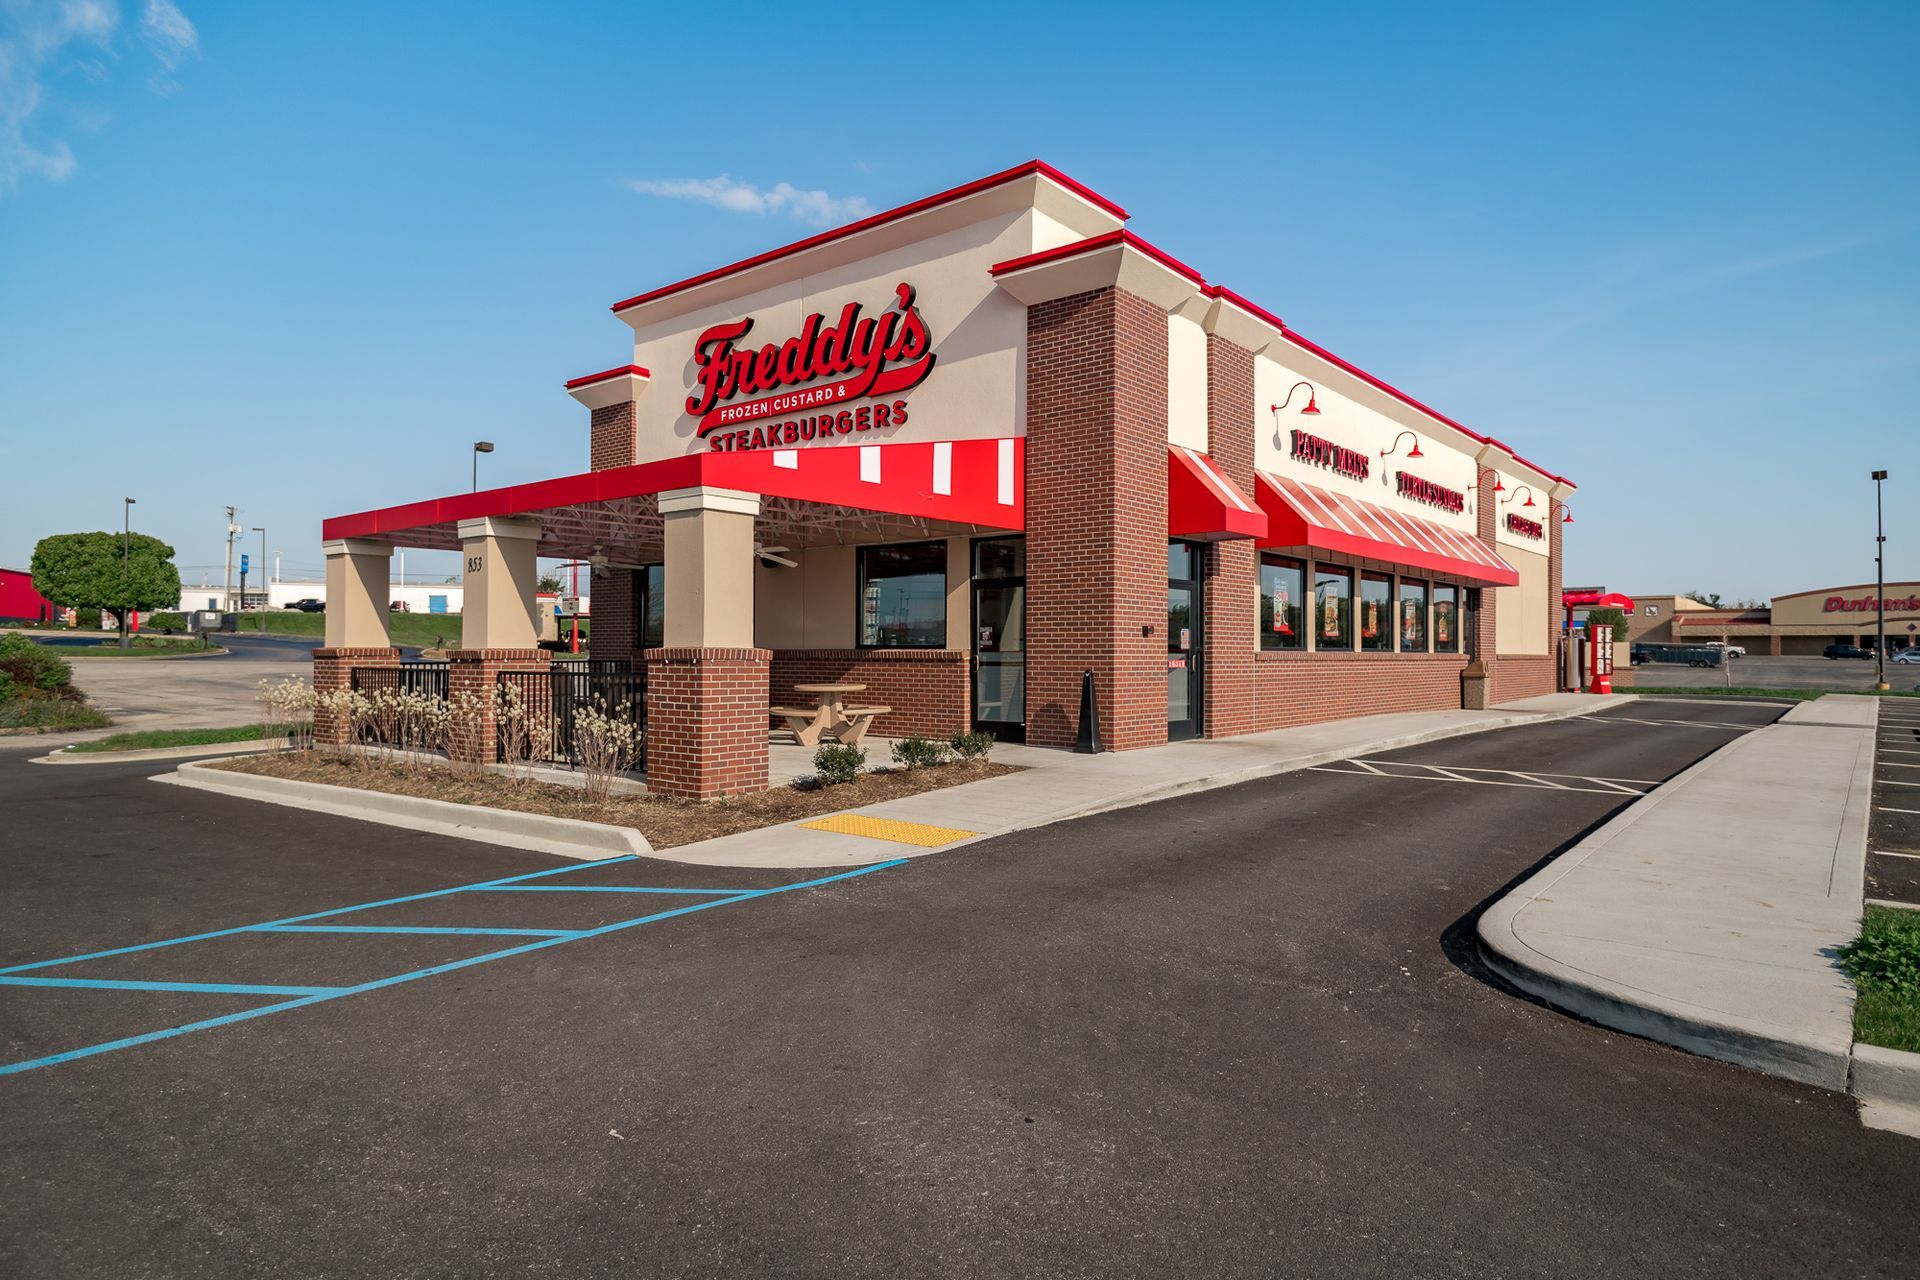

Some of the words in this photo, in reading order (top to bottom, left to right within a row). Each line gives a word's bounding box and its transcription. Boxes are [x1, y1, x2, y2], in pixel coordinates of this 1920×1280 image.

[686, 282, 937, 436] Freddy's
[710, 401, 908, 452] STEAKBURGERS
[721, 402, 768, 421] FROZEN
[774, 388, 833, 411] CUSTARD
[838, 385, 846, 397] &
[1291, 429, 1334, 466] PATTY
[1334, 446, 1369, 478] MELTS
[468, 557, 482, 573] 853
